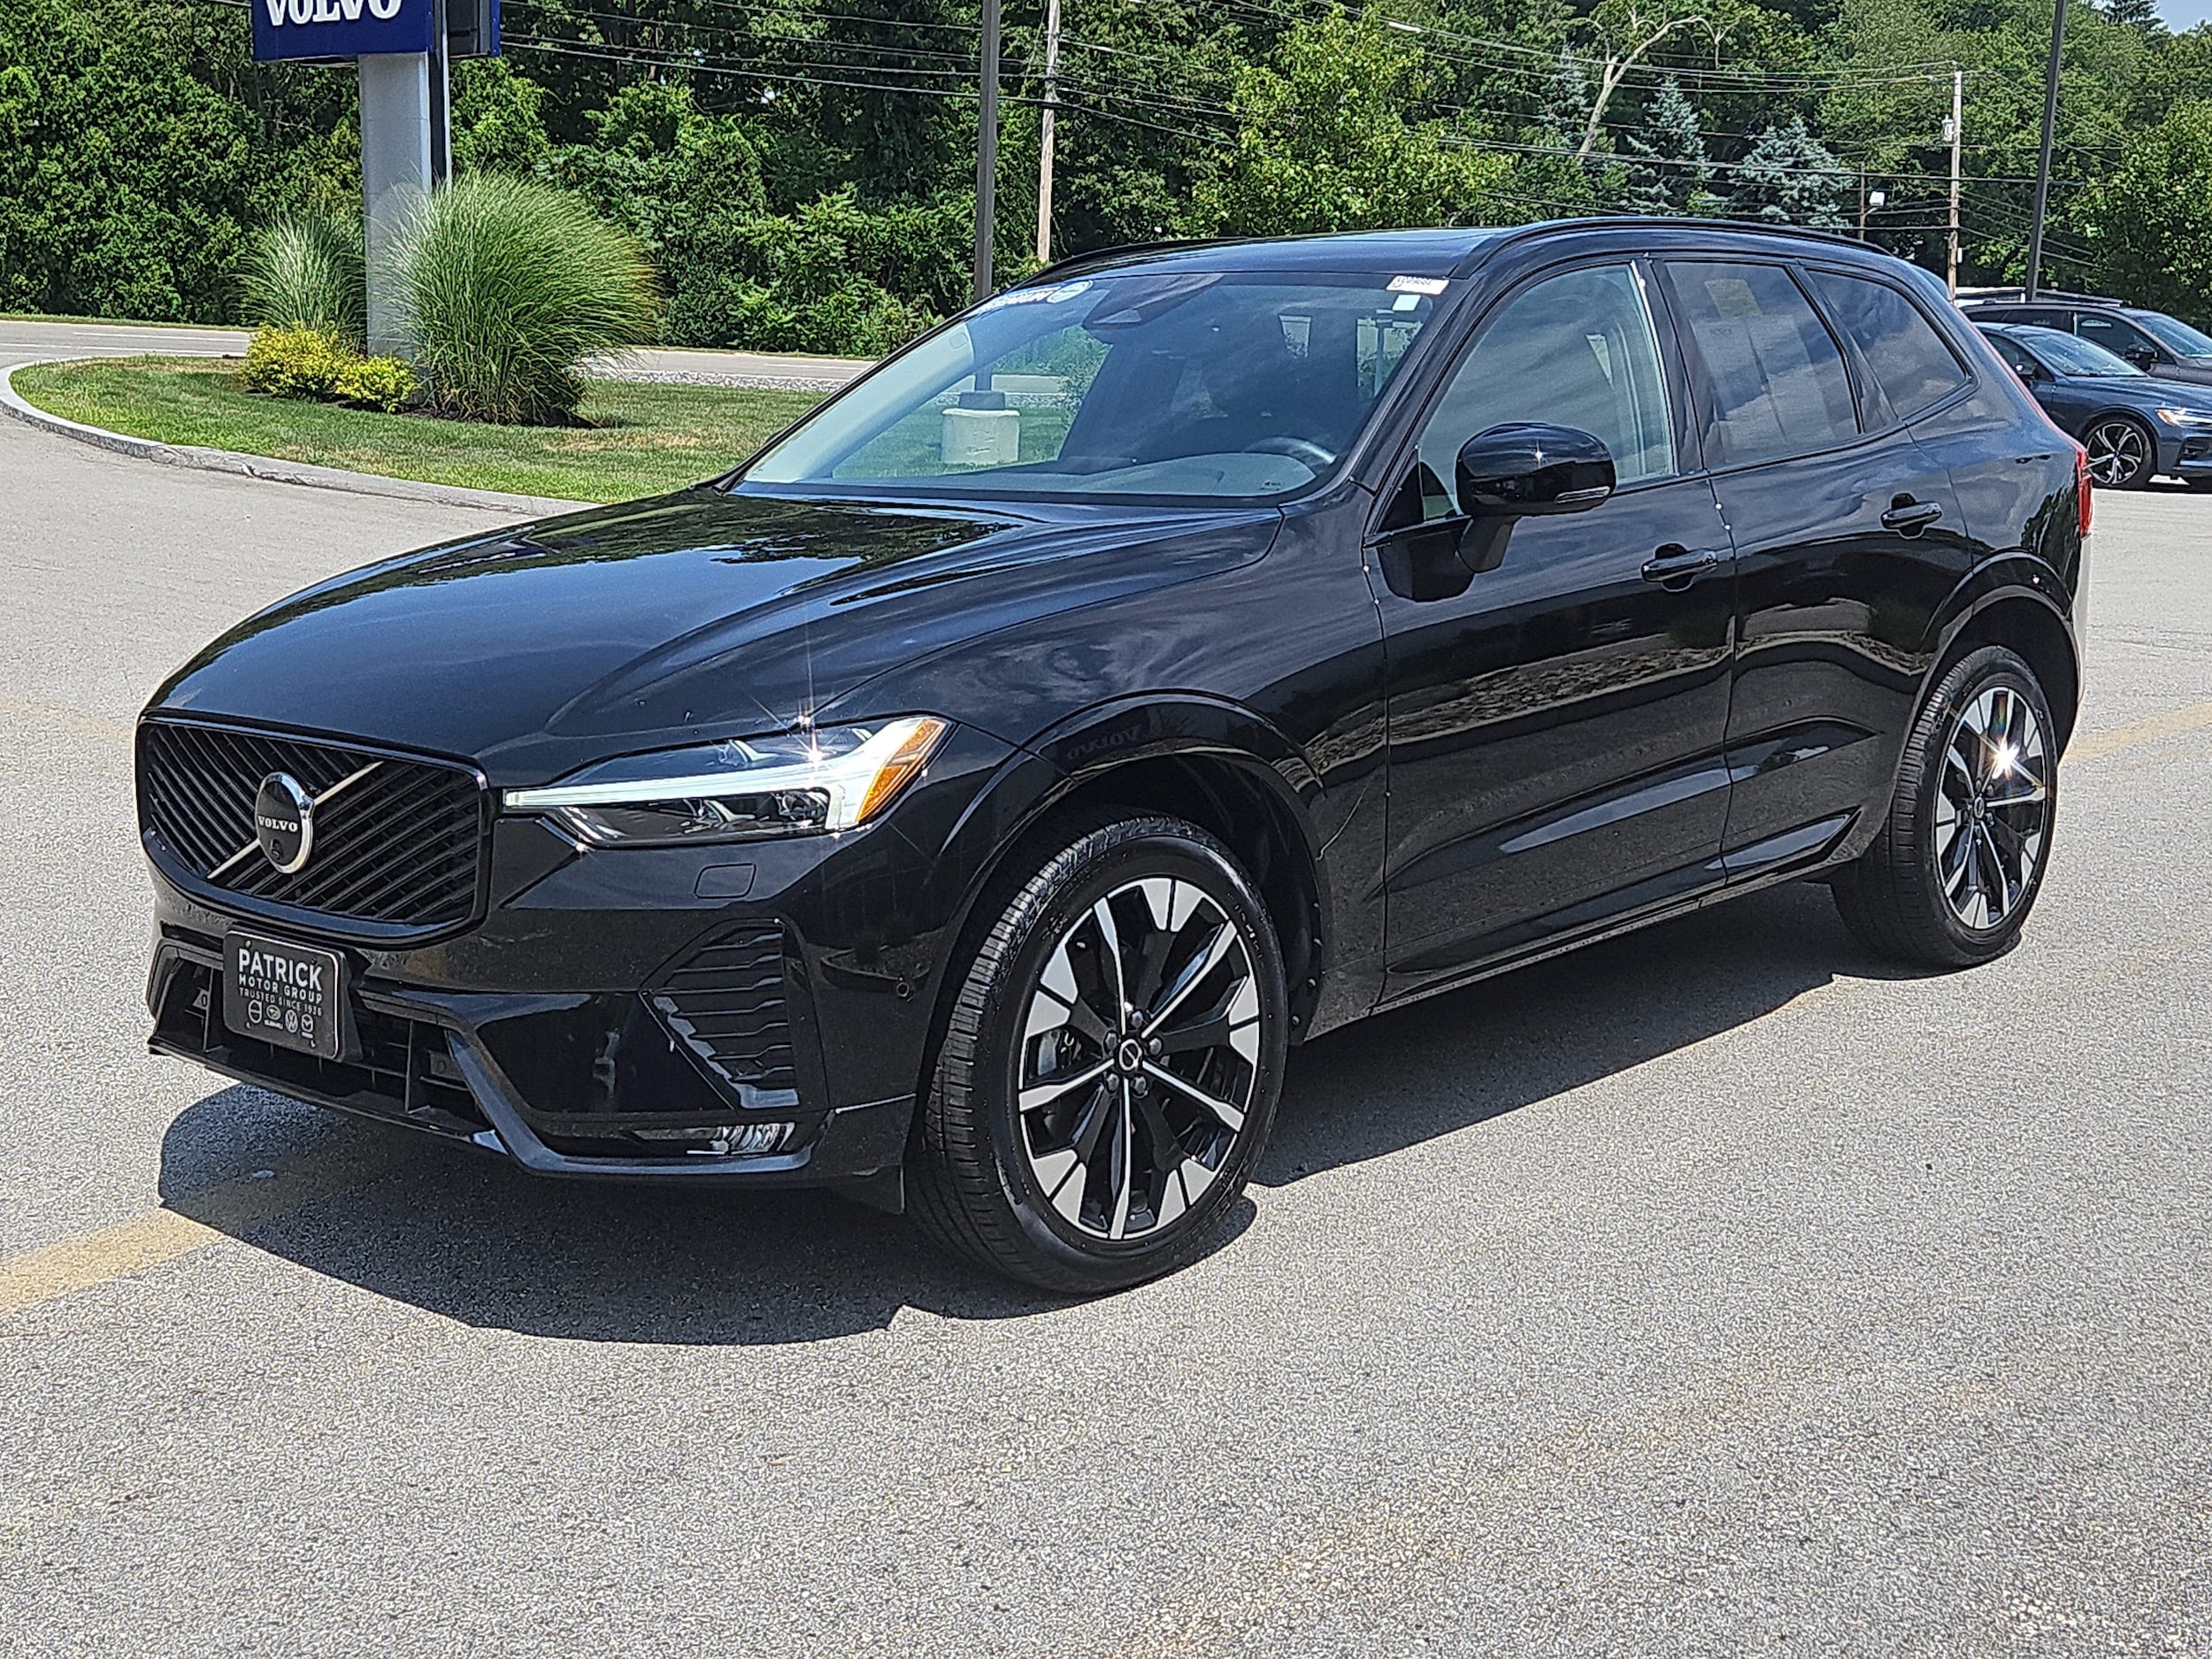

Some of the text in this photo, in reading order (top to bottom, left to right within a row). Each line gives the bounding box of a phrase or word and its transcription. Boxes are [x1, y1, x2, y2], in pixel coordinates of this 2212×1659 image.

[258, 816, 298, 833] VOLVO
[239, 948, 322, 991] PATRICK
[239, 974, 322, 1004] MOTOR GROUP
[239, 987, 276, 1002] TRUSTED
[279, 996, 301, 1011] SINCE
